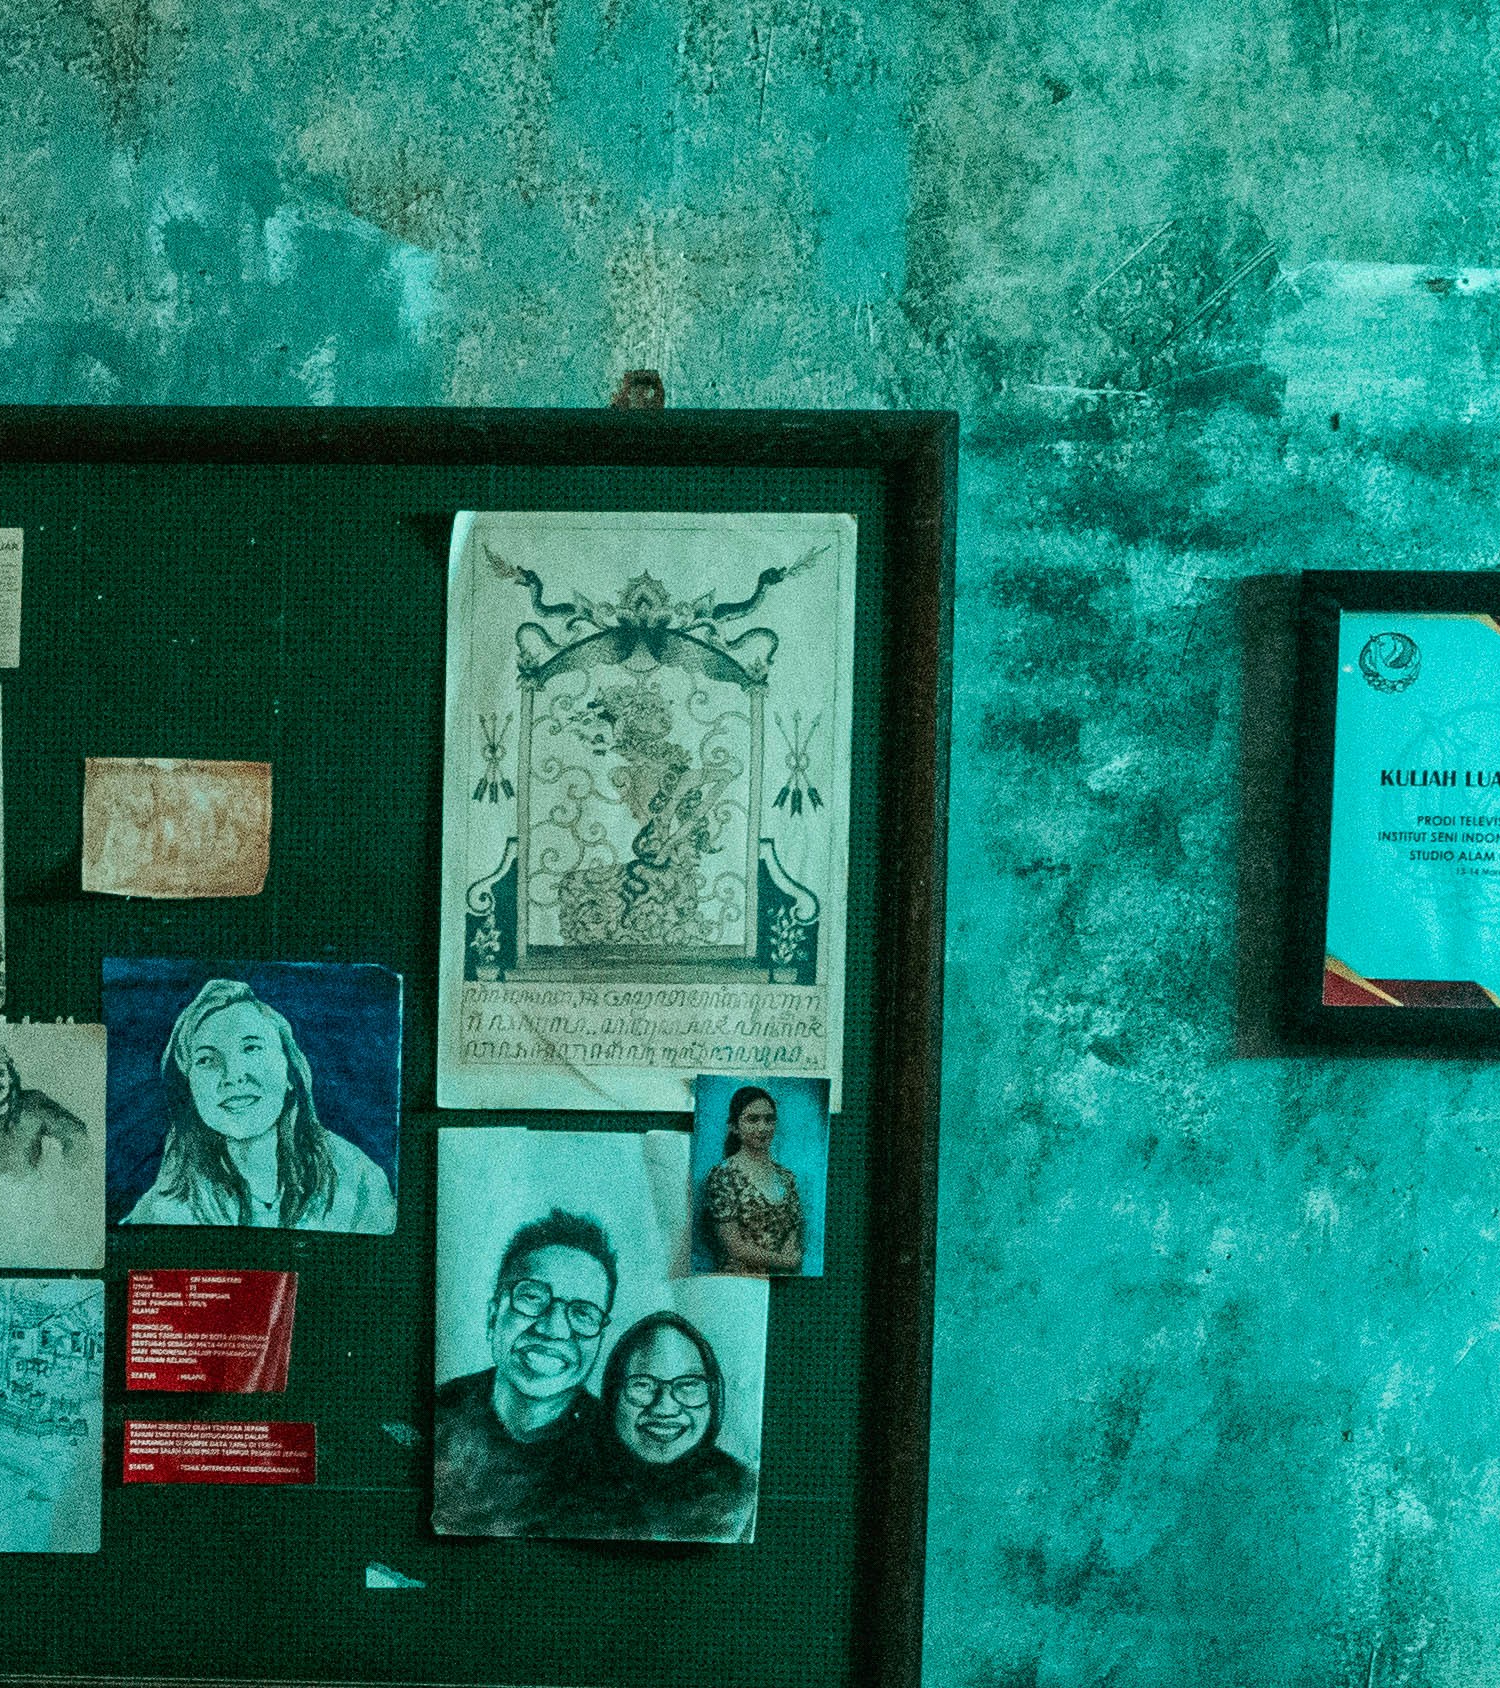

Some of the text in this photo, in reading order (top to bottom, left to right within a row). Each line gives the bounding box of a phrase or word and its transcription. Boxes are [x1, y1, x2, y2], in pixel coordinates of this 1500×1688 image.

[1380, 769, 1457, 787] KULIAH
[1417, 815, 1456, 827] PRODI
[1378, 831, 1428, 842] INSTITUT
[1431, 831, 1458, 843] SENI
[1409, 850, 1455, 862] STUDIO
[1458, 850, 1495, 862] ALAM
